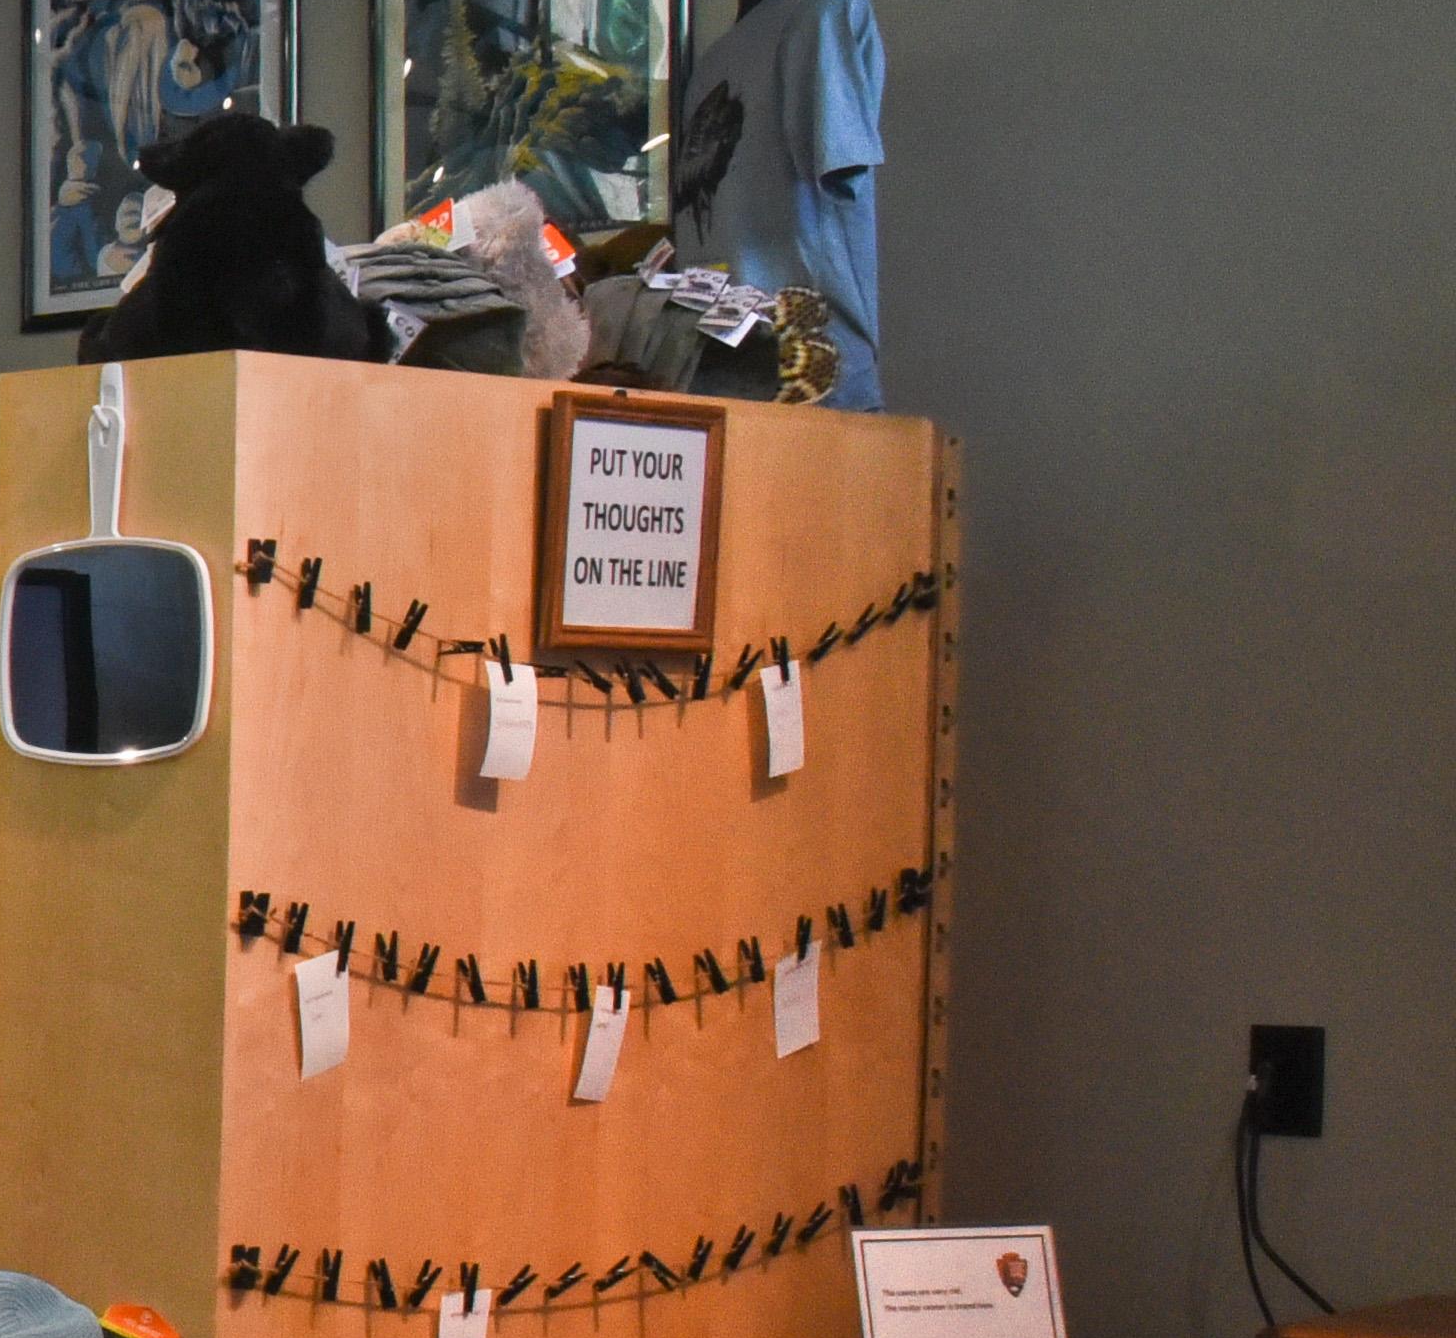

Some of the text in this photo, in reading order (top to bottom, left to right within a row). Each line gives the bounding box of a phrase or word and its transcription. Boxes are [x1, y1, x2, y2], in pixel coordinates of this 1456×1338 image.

[590, 447, 684, 480] PUT YOUR
[582, 502, 685, 534] THOUGHTS
[573, 556, 687, 588] ON THE LINE
